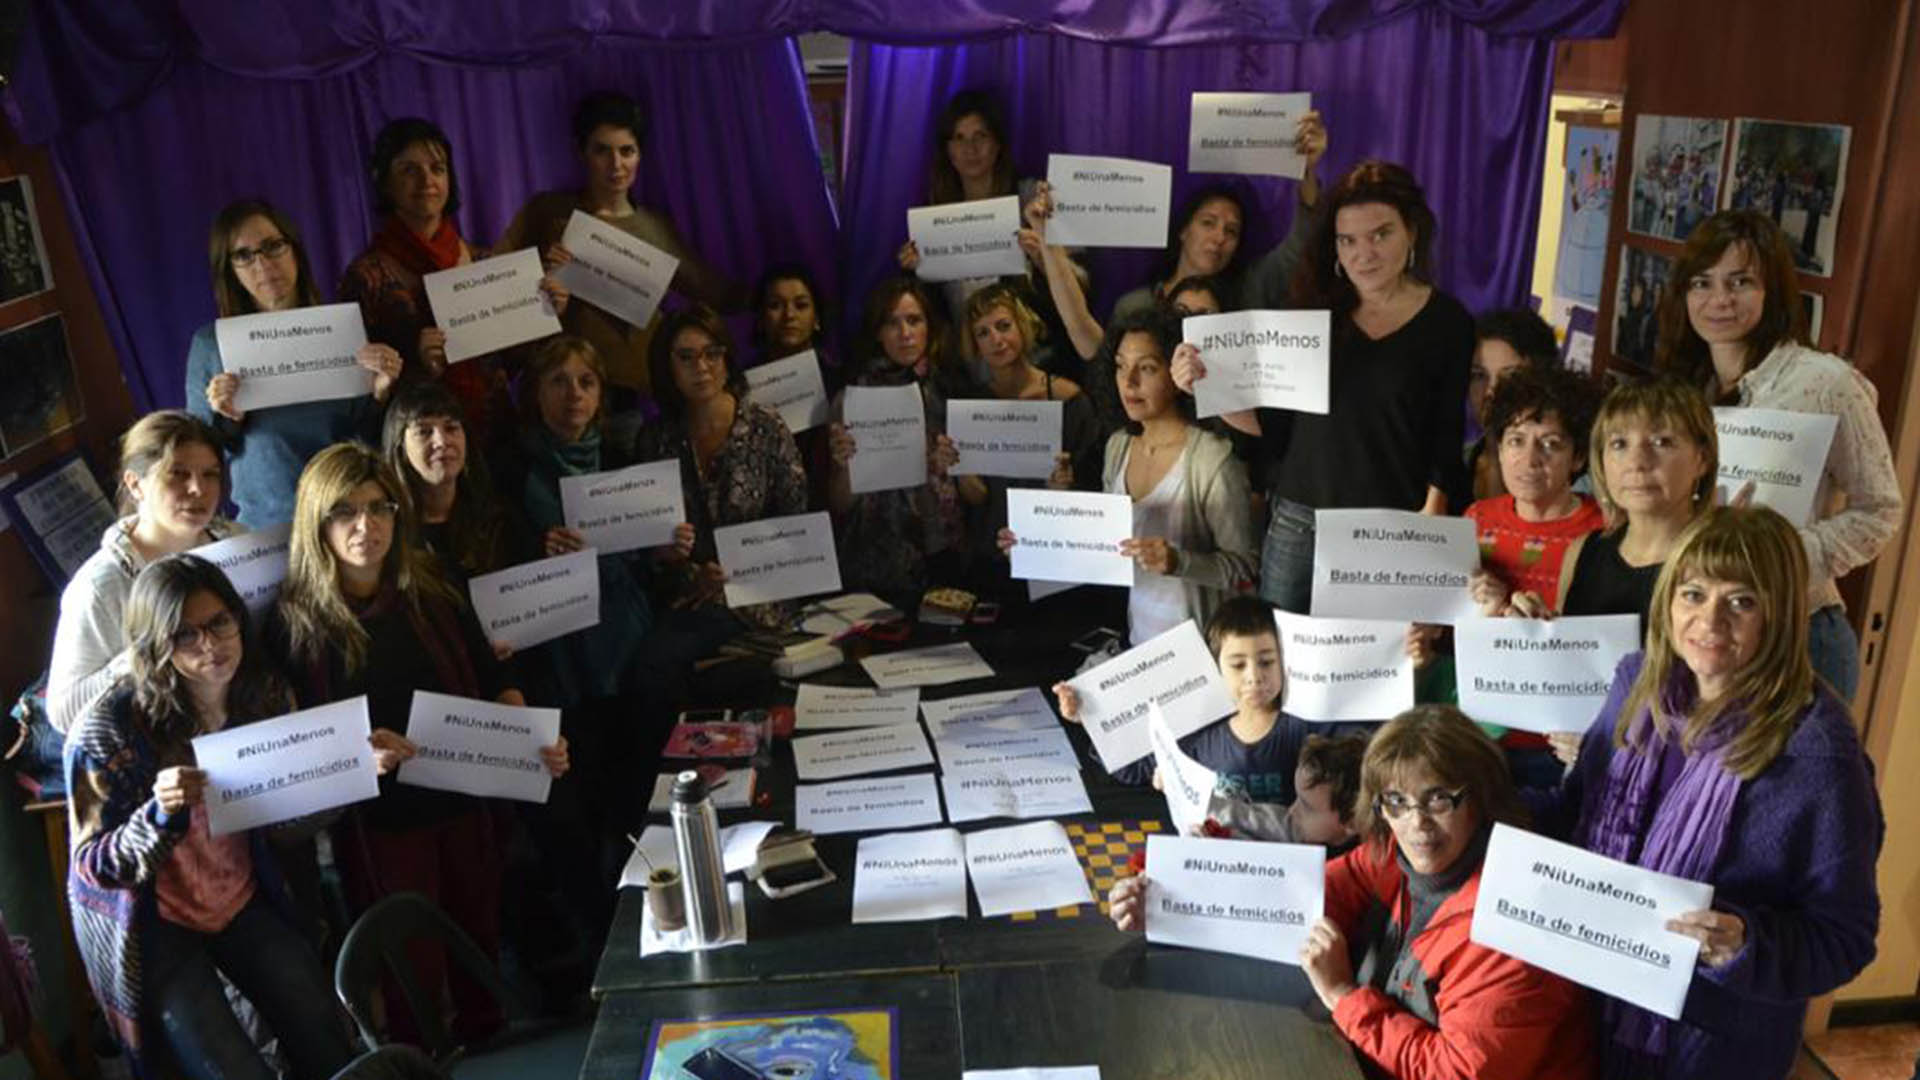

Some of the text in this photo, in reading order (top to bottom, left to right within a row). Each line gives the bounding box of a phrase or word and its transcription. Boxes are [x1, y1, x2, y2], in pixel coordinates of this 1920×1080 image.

[1073, 171, 1143, 184] #NiUnaMenos
[1057, 203, 1156, 214] Basta de femicidios
[933, 212, 995, 225] #NiUnaMenos
[453, 268, 519, 292] #NiUnaMenos
[249, 324, 332, 341] #NiUnaMenos
[1203, 332, 1320, 350] #NiUnaMenos
[239, 363, 274, 379] Basta
[278, 362, 293, 375] de
[1731, 464, 1802, 487] femicidios
[1033, 505, 1104, 519] #NiUnaMenos
[1020, 536, 1118, 554] Basta de femicidios
[1352, 528, 1447, 545] #NiUnaMenos
[499, 567, 571, 594] #NiUnaMenos
[1330, 569, 1469, 588] Basta de femicidios
[490, 592, 590, 629] Basta de femicidios
[1293, 632, 1375, 645] #NiUnaMenos
[1493, 639, 1600, 652] #NiUnaMenos
[1100, 649, 1176, 691] #NiUnaMenos
[1312, 671, 1327, 683] de
[1330, 667, 1399, 683] femicidios
[1474, 677, 1515, 693] Basta
[1518, 679, 1536, 694] de
[444, 714, 531, 736] #NiUnaMenos
[1101, 709, 1132, 733] Basta
[1133, 701, 1150, 719] de
[236, 726, 336, 760] #NiUnaMenos
[420, 744, 542, 772] Basta de femicidios
[222, 757, 359, 801] Basta de femicidios
[961, 774, 1072, 792] #NiUnaMenos
[863, 857, 958, 870] #NiUnaMenos
[974, 846, 1067, 864] #NiUnaMenos
[1183, 859, 1286, 879] #NiUnaMenos
[1531, 861, 1658, 910] #NiUnaMenos
[1162, 898, 1306, 926] Basta de femicidios
[1496, 898, 1672, 970] Basta de femicidios
